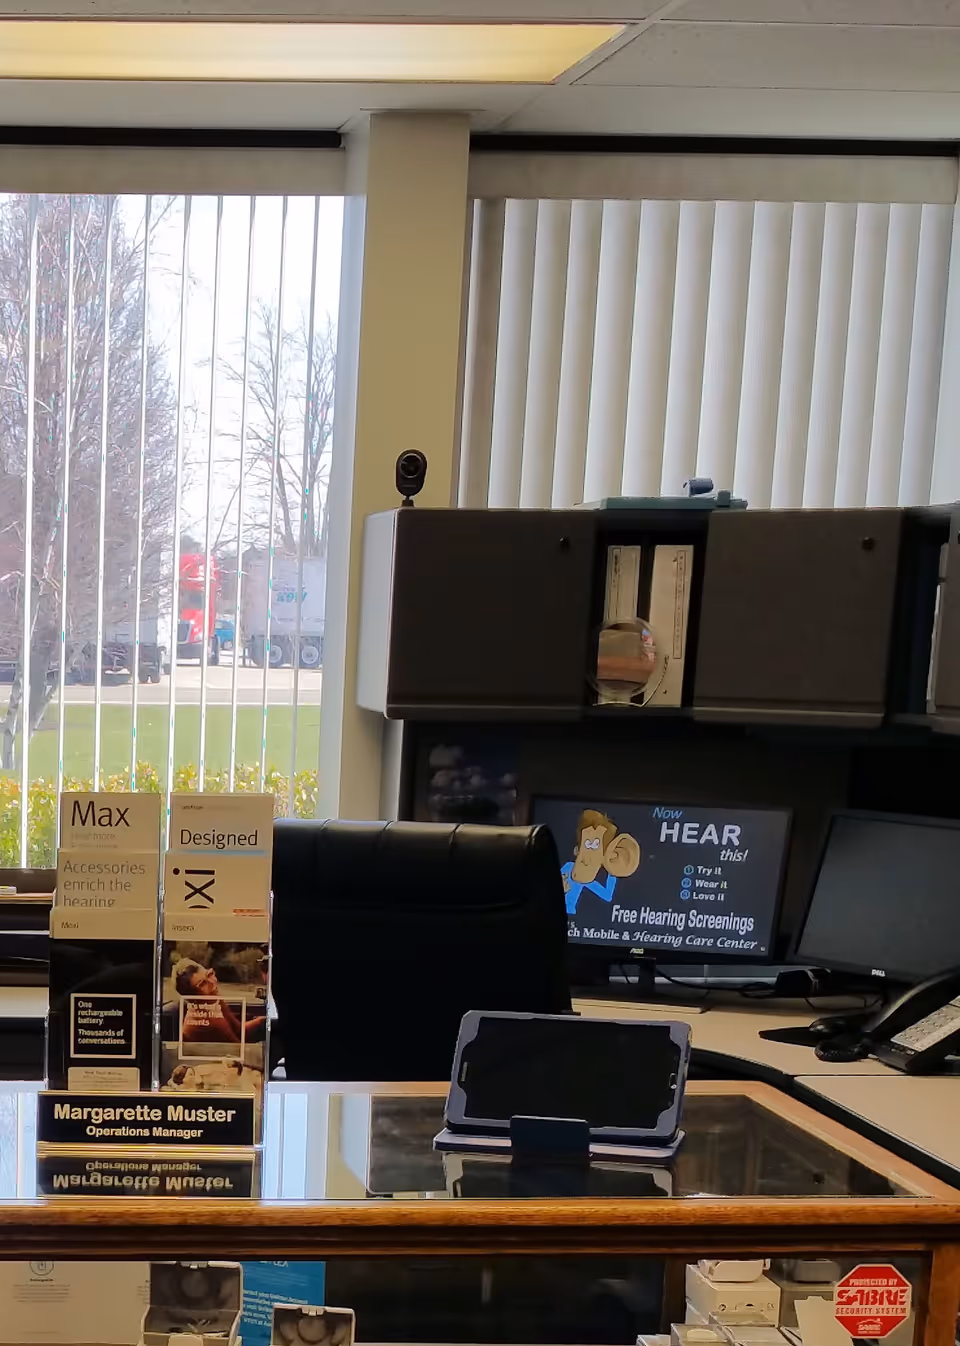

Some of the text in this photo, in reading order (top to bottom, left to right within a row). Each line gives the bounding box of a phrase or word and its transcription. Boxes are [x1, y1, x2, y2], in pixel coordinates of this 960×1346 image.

[71, 800, 130, 827] Max
[652, 807, 683, 819] Now
[180, 829, 258, 850] Designed
[659, 821, 741, 846] HEAR
[720, 849, 748, 862] this!
[63, 860, 146, 875] Accessories
[697, 866, 712, 876] Try
[714, 866, 722, 876] it
[63, 878, 132, 892] enrich the
[695, 879, 719, 888] Wear
[720, 880, 727, 889] it
[63, 895, 116, 908] hearing
[693, 892, 715, 900] Love
[718, 892, 725, 901] it
[611, 905, 755, 936] Free Hearing Screenings
[583, 927, 620, 939] Mobile
[622, 932, 630, 941] &
[632, 931, 683, 947] Hearing
[686, 937, 714, 947] Care
[717, 938, 758, 950] Center
[54, 1104, 236, 1124] Margarette Muster
[86, 1126, 204, 1139] Operations Manager
[835, 1289, 908, 1306] SABRE
[835, 1307, 906, 1315] SECURITY SYSTEM
